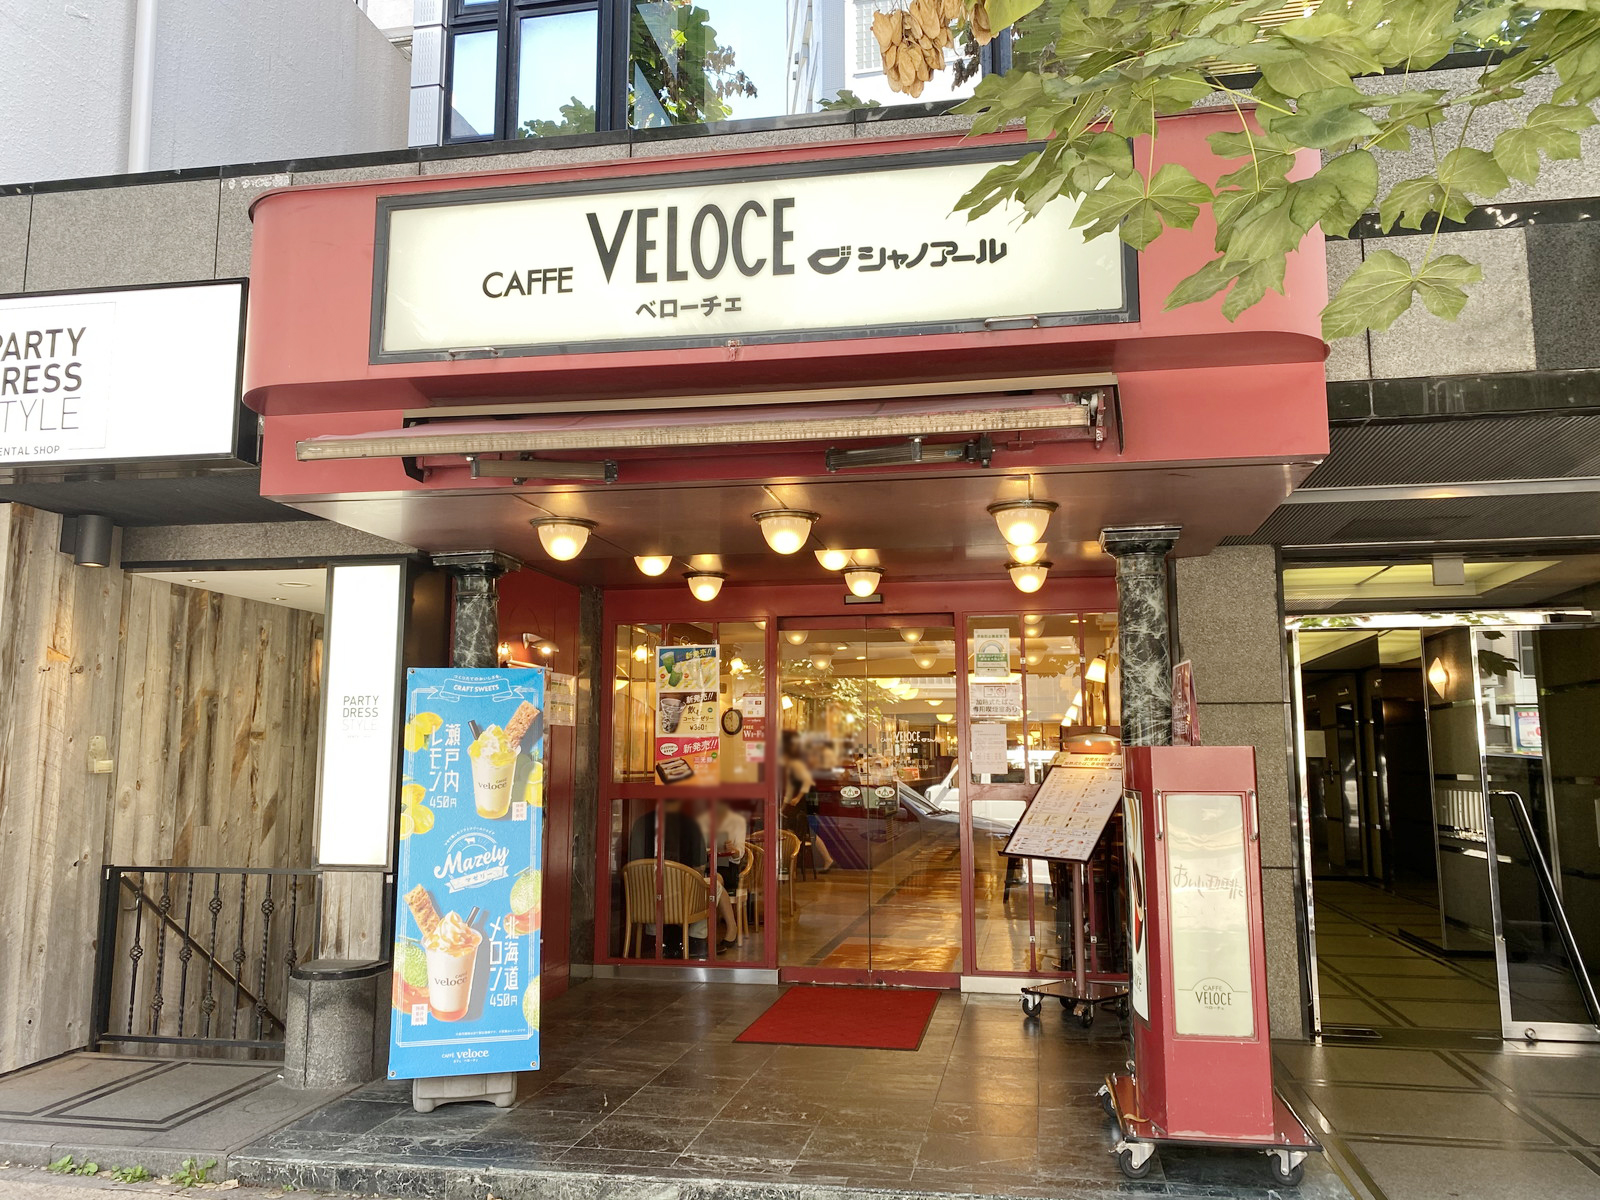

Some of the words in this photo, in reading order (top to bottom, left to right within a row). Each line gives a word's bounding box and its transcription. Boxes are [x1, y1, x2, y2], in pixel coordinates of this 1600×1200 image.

[482, 266, 574, 298] CAFFE
[586, 197, 795, 285] VELOCE
[857, 238, 1008, 273] シャノアール
[635, 295, 742, 319] ベローチェ
[0, 327, 87, 362] ARTY
[33, 445, 60, 455] SHOP
[453, 684, 474, 692] CRAFT
[474, 684, 500, 692] SWEETS
[343, 695, 380, 706] PARTY
[342, 707, 379, 718] DRESS
[894, 730, 921, 742] VELOCE
[429, 724, 443, 792] レモン
[444, 723, 461, 793] 瀬戸内
[429, 795, 457, 808] 450円
[433, 844, 510, 879] Mazely
[489, 916, 503, 992] メロン
[504, 915, 519, 991] 北海道
[489, 993, 518, 1007] 450円
[1195, 991, 1232, 1006] VELOCE
[456, 1048, 490, 1059] veloce
